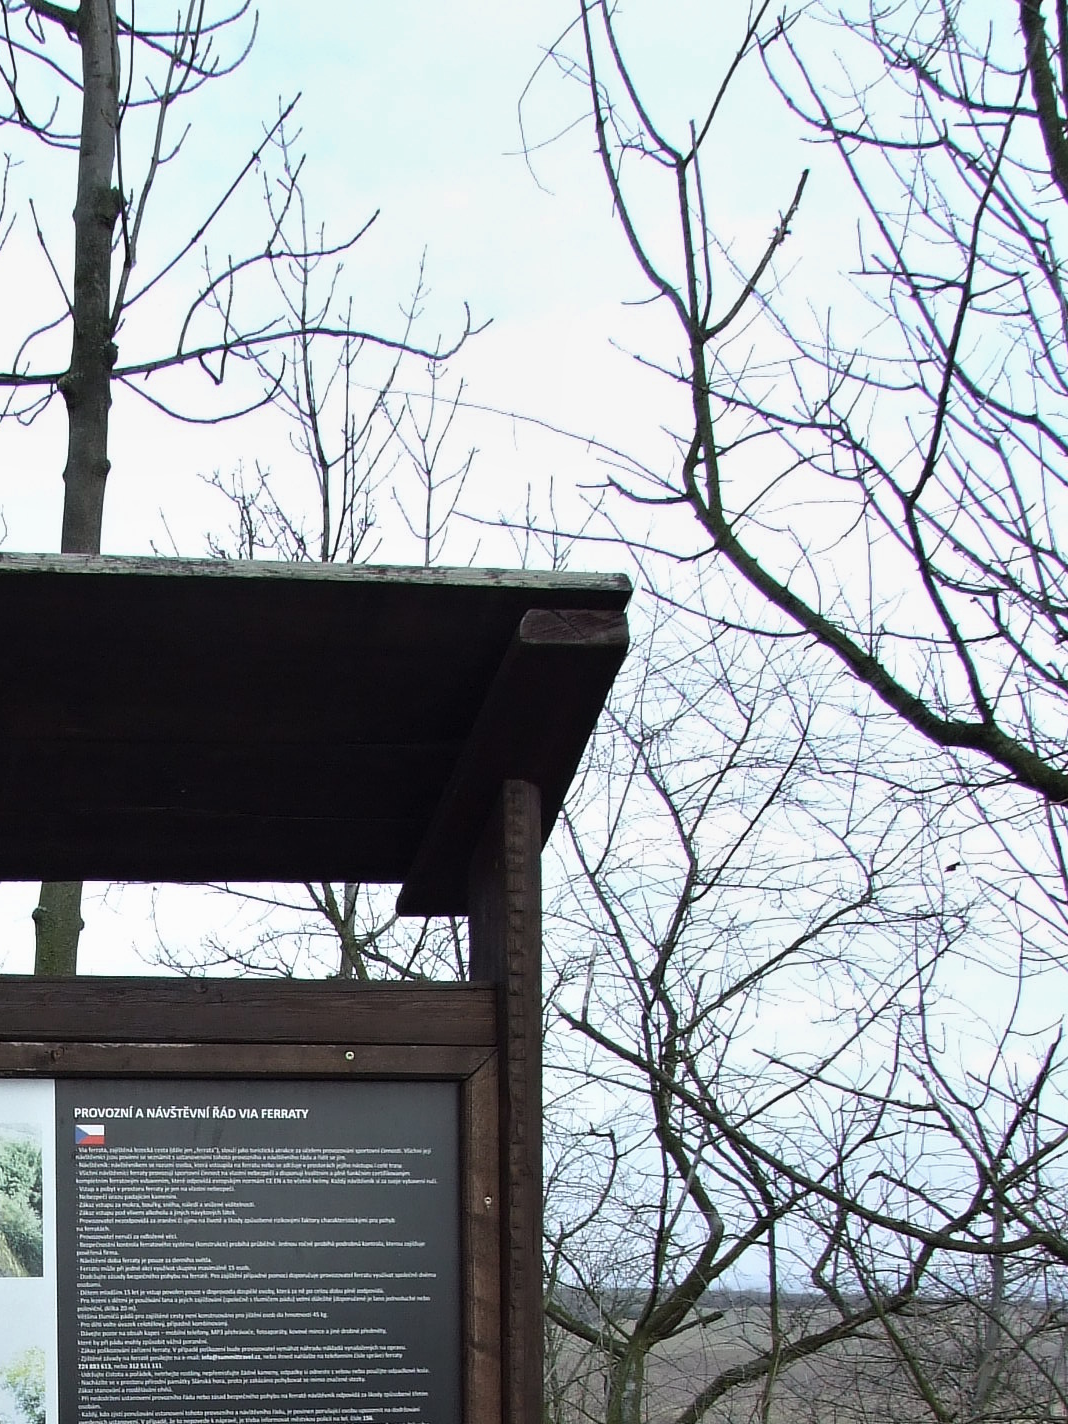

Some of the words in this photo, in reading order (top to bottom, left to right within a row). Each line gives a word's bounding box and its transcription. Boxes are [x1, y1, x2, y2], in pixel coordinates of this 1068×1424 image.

[74, 1106, 132, 1119] PROVOZNÍ
[135, 1108, 144, 1118] A
[146, 1105, 209, 1119] NÁVŠTĚVNÍ
[212, 1106, 236, 1119] ŘÁD
[240, 1109, 258, 1119] VIA
[261, 1109, 309, 1119] FERRATY
